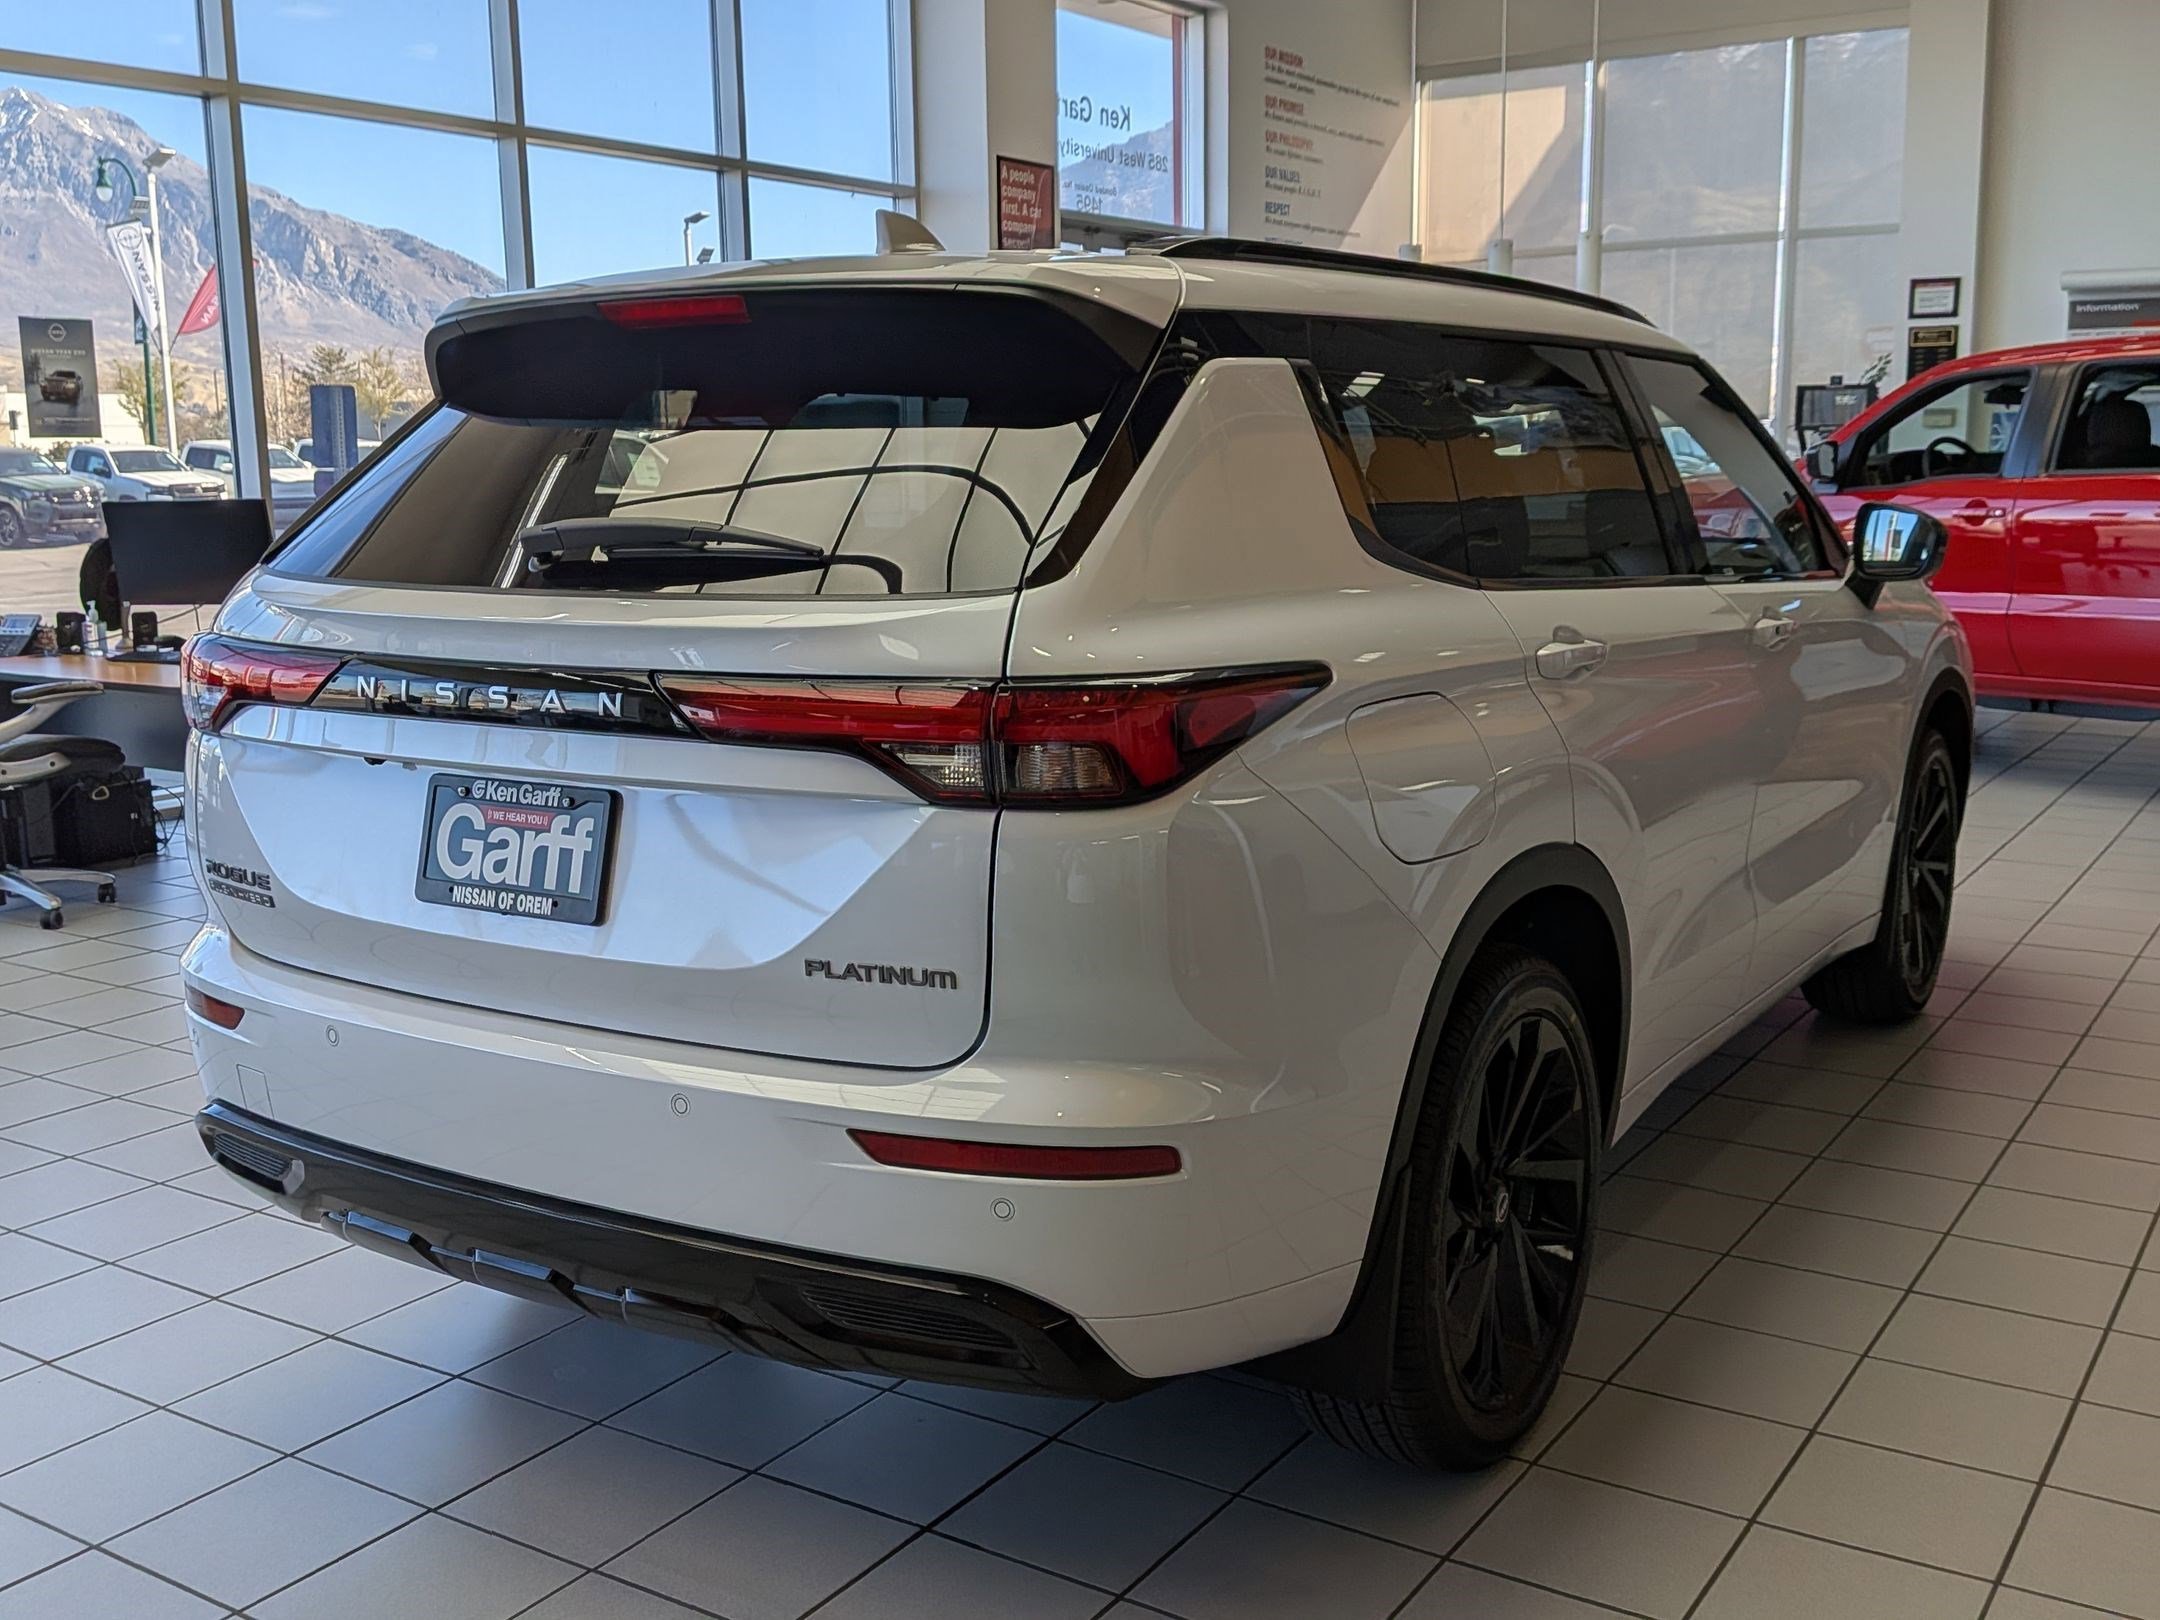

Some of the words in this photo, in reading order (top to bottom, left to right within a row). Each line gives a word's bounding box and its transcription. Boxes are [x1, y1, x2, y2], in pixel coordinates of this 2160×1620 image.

[1002, 164, 1008, 179] A
[1009, 169, 1035, 184] people
[1265, 165, 1278, 178] OUR
[1002, 185, 1036, 204] company
[1022, 203, 1028, 217] A
[1029, 206, 1042, 218] car
[1264, 201, 1290, 216] RESPECT
[1002, 220, 1036, 234] company
[2076, 303, 2139, 313] Information
[357, 676, 623, 718] NISSAN
[485, 781, 517, 802] Ken
[519, 784, 562, 807] Garff
[493, 810, 504, 821] WE
[506, 812, 526, 822] HEAR
[527, 814, 543, 825] YOU
[436, 803, 595, 894] Garff
[205, 858, 271, 891] ROGUE
[452, 885, 496, 908] NISSAN
[499, 891, 515, 911] OF
[517, 894, 553, 915] OREM
[804, 958, 957, 990] PLATINUM
